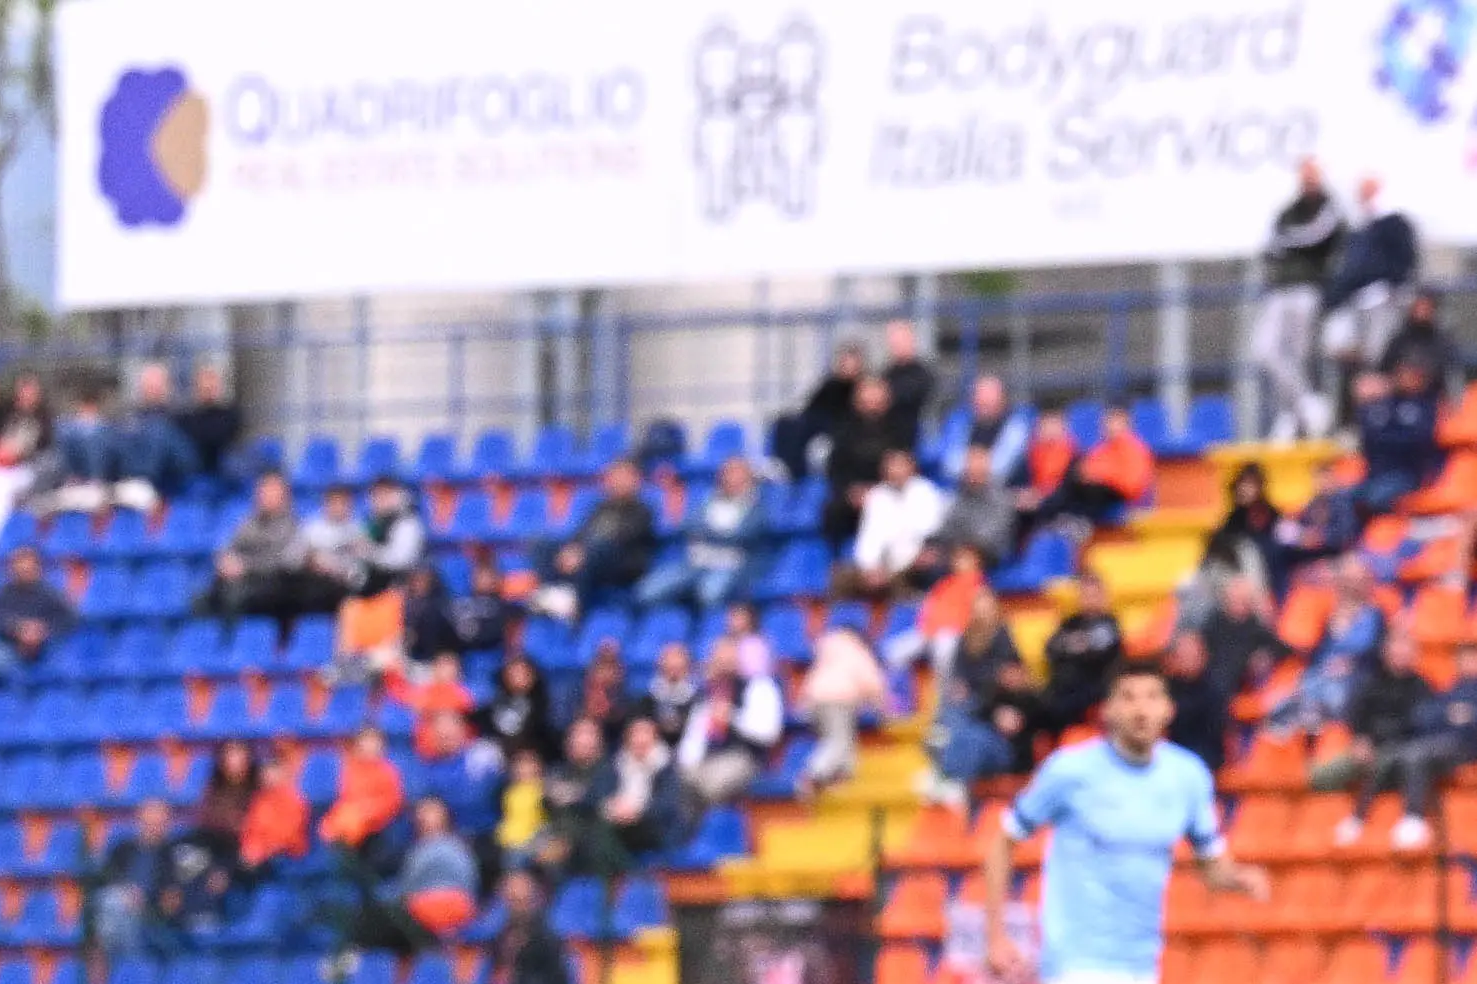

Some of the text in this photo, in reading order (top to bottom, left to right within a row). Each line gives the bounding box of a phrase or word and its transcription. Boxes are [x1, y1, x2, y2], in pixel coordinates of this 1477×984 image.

[886, 2, 1305, 102] Bodyguard
[867, 97, 1322, 189] Italia Service
